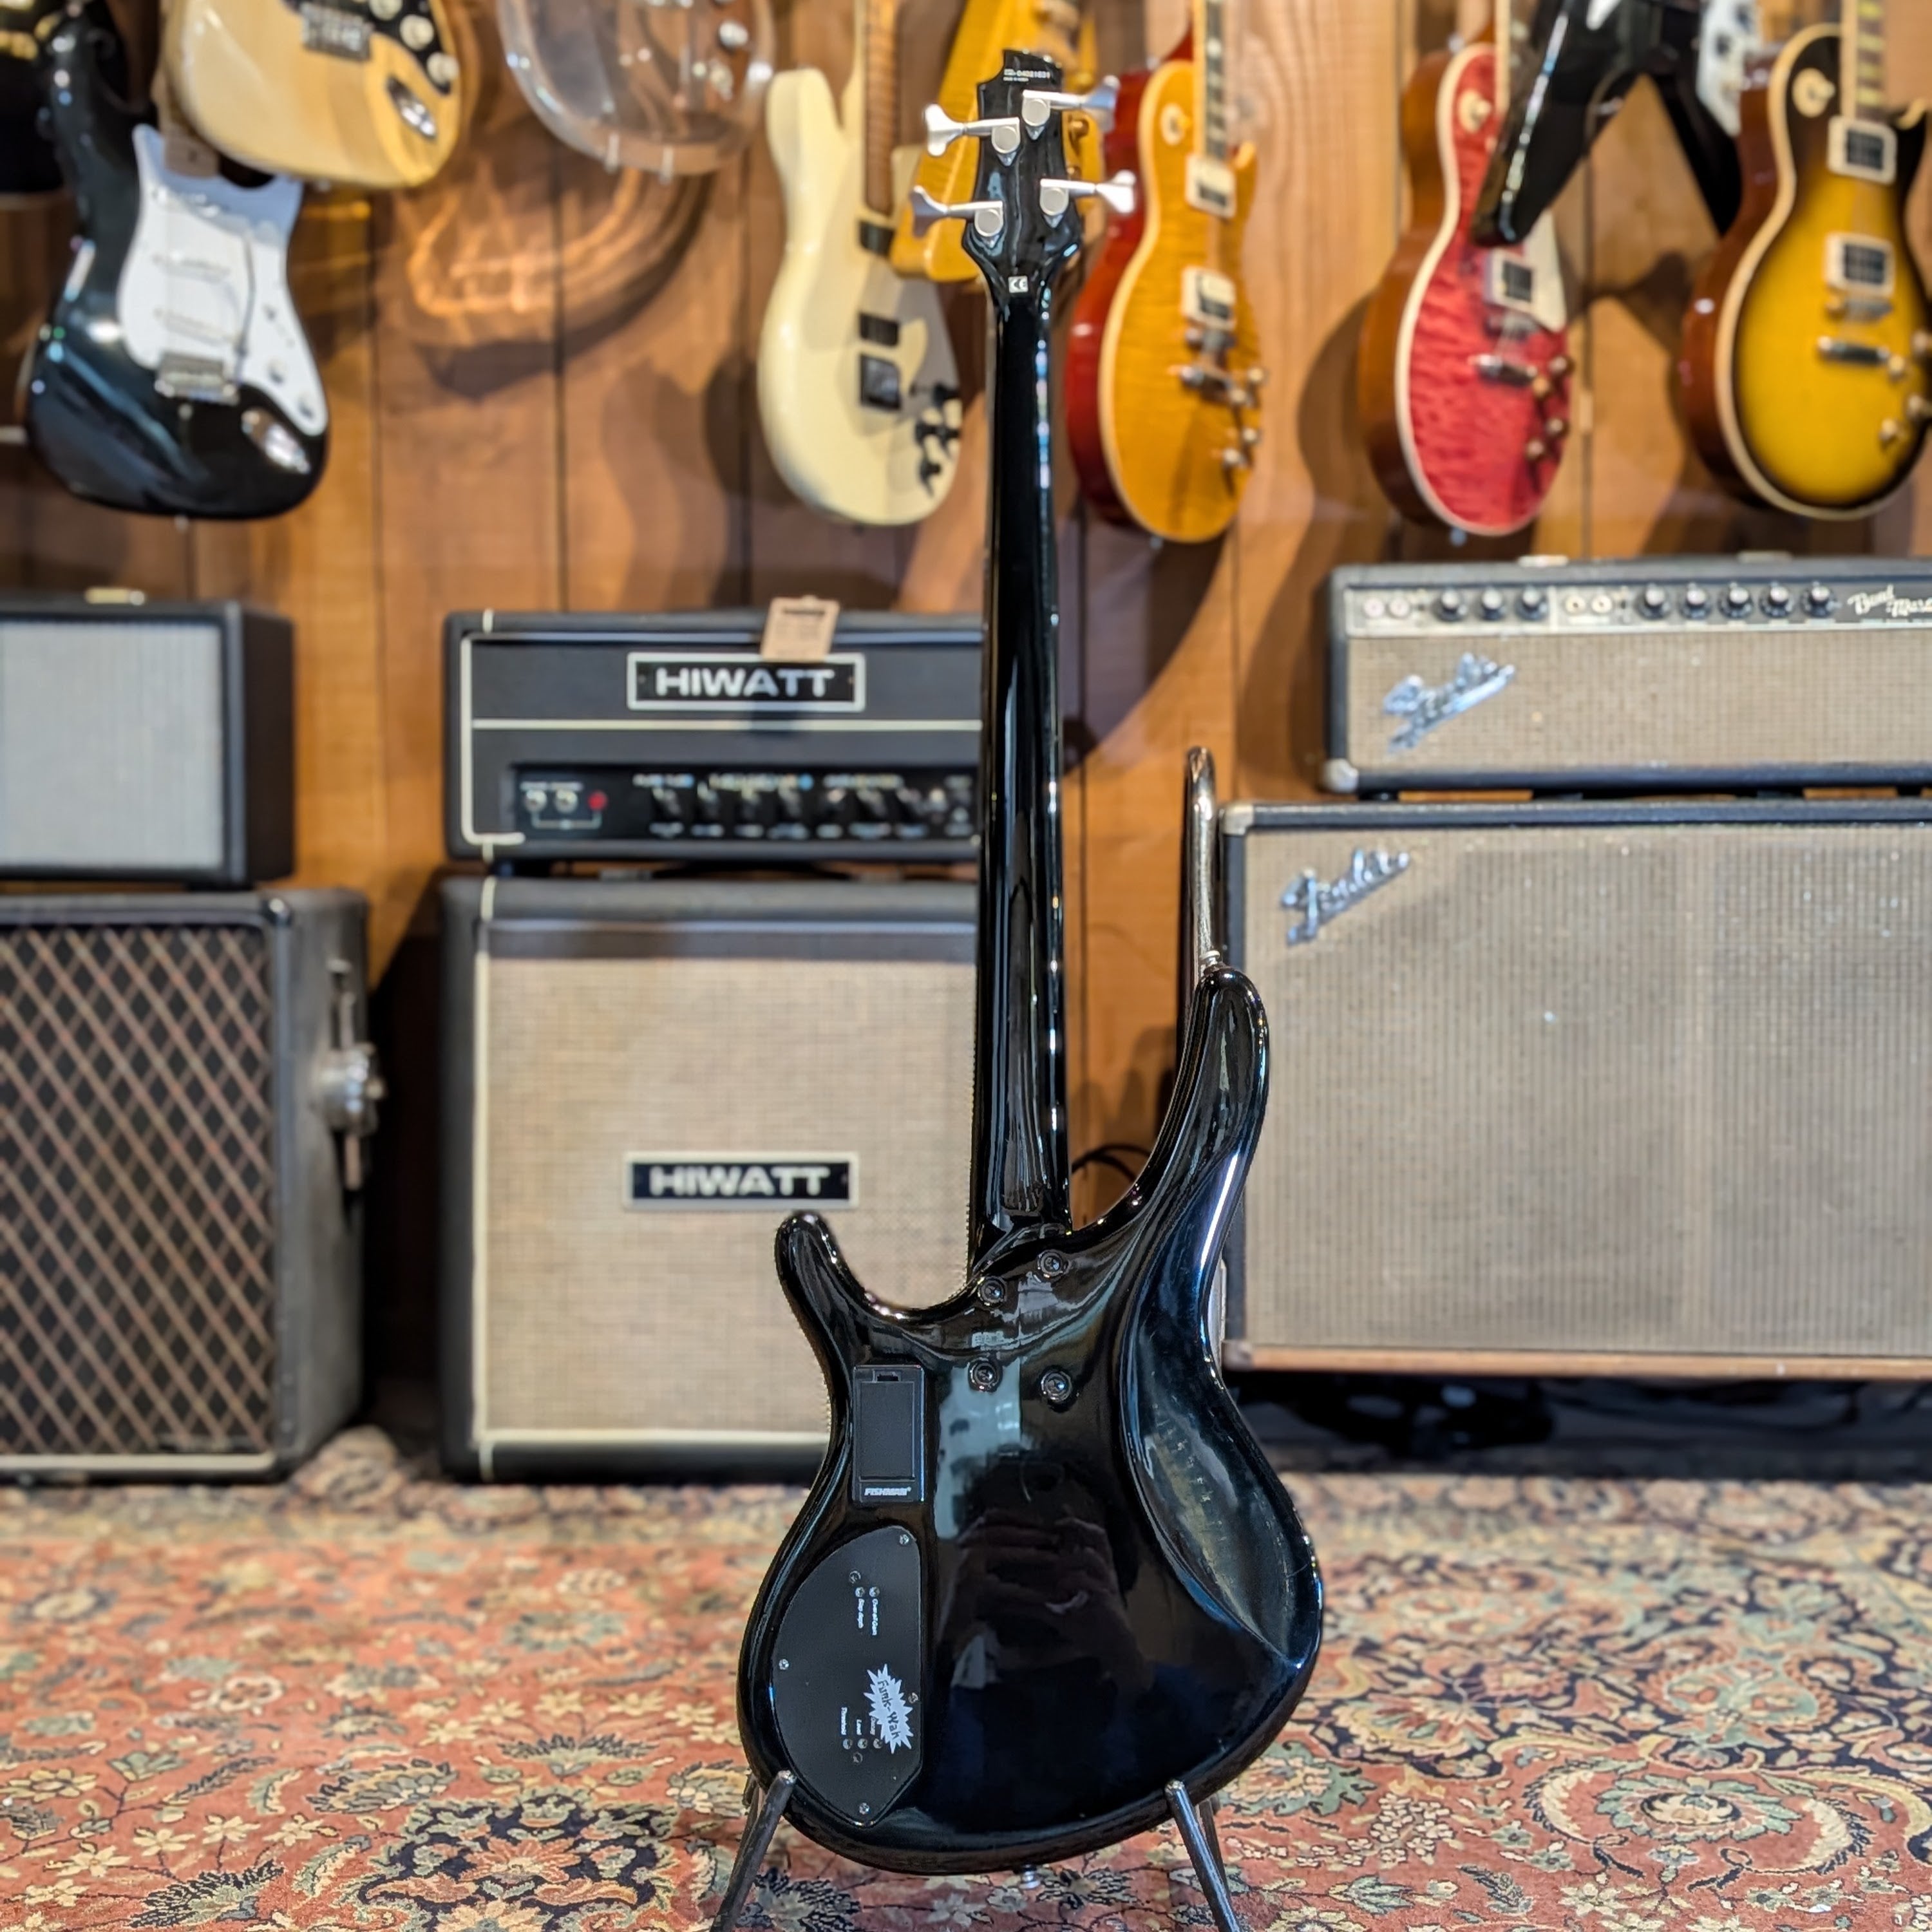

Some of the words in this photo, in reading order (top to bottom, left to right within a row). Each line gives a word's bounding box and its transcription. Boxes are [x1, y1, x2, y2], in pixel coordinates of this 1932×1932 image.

[656, 667, 835, 697] HIWATT
[649, 1166, 831, 1196] HIWATT
[877, 1679, 902, 1739] Funk-Wah
